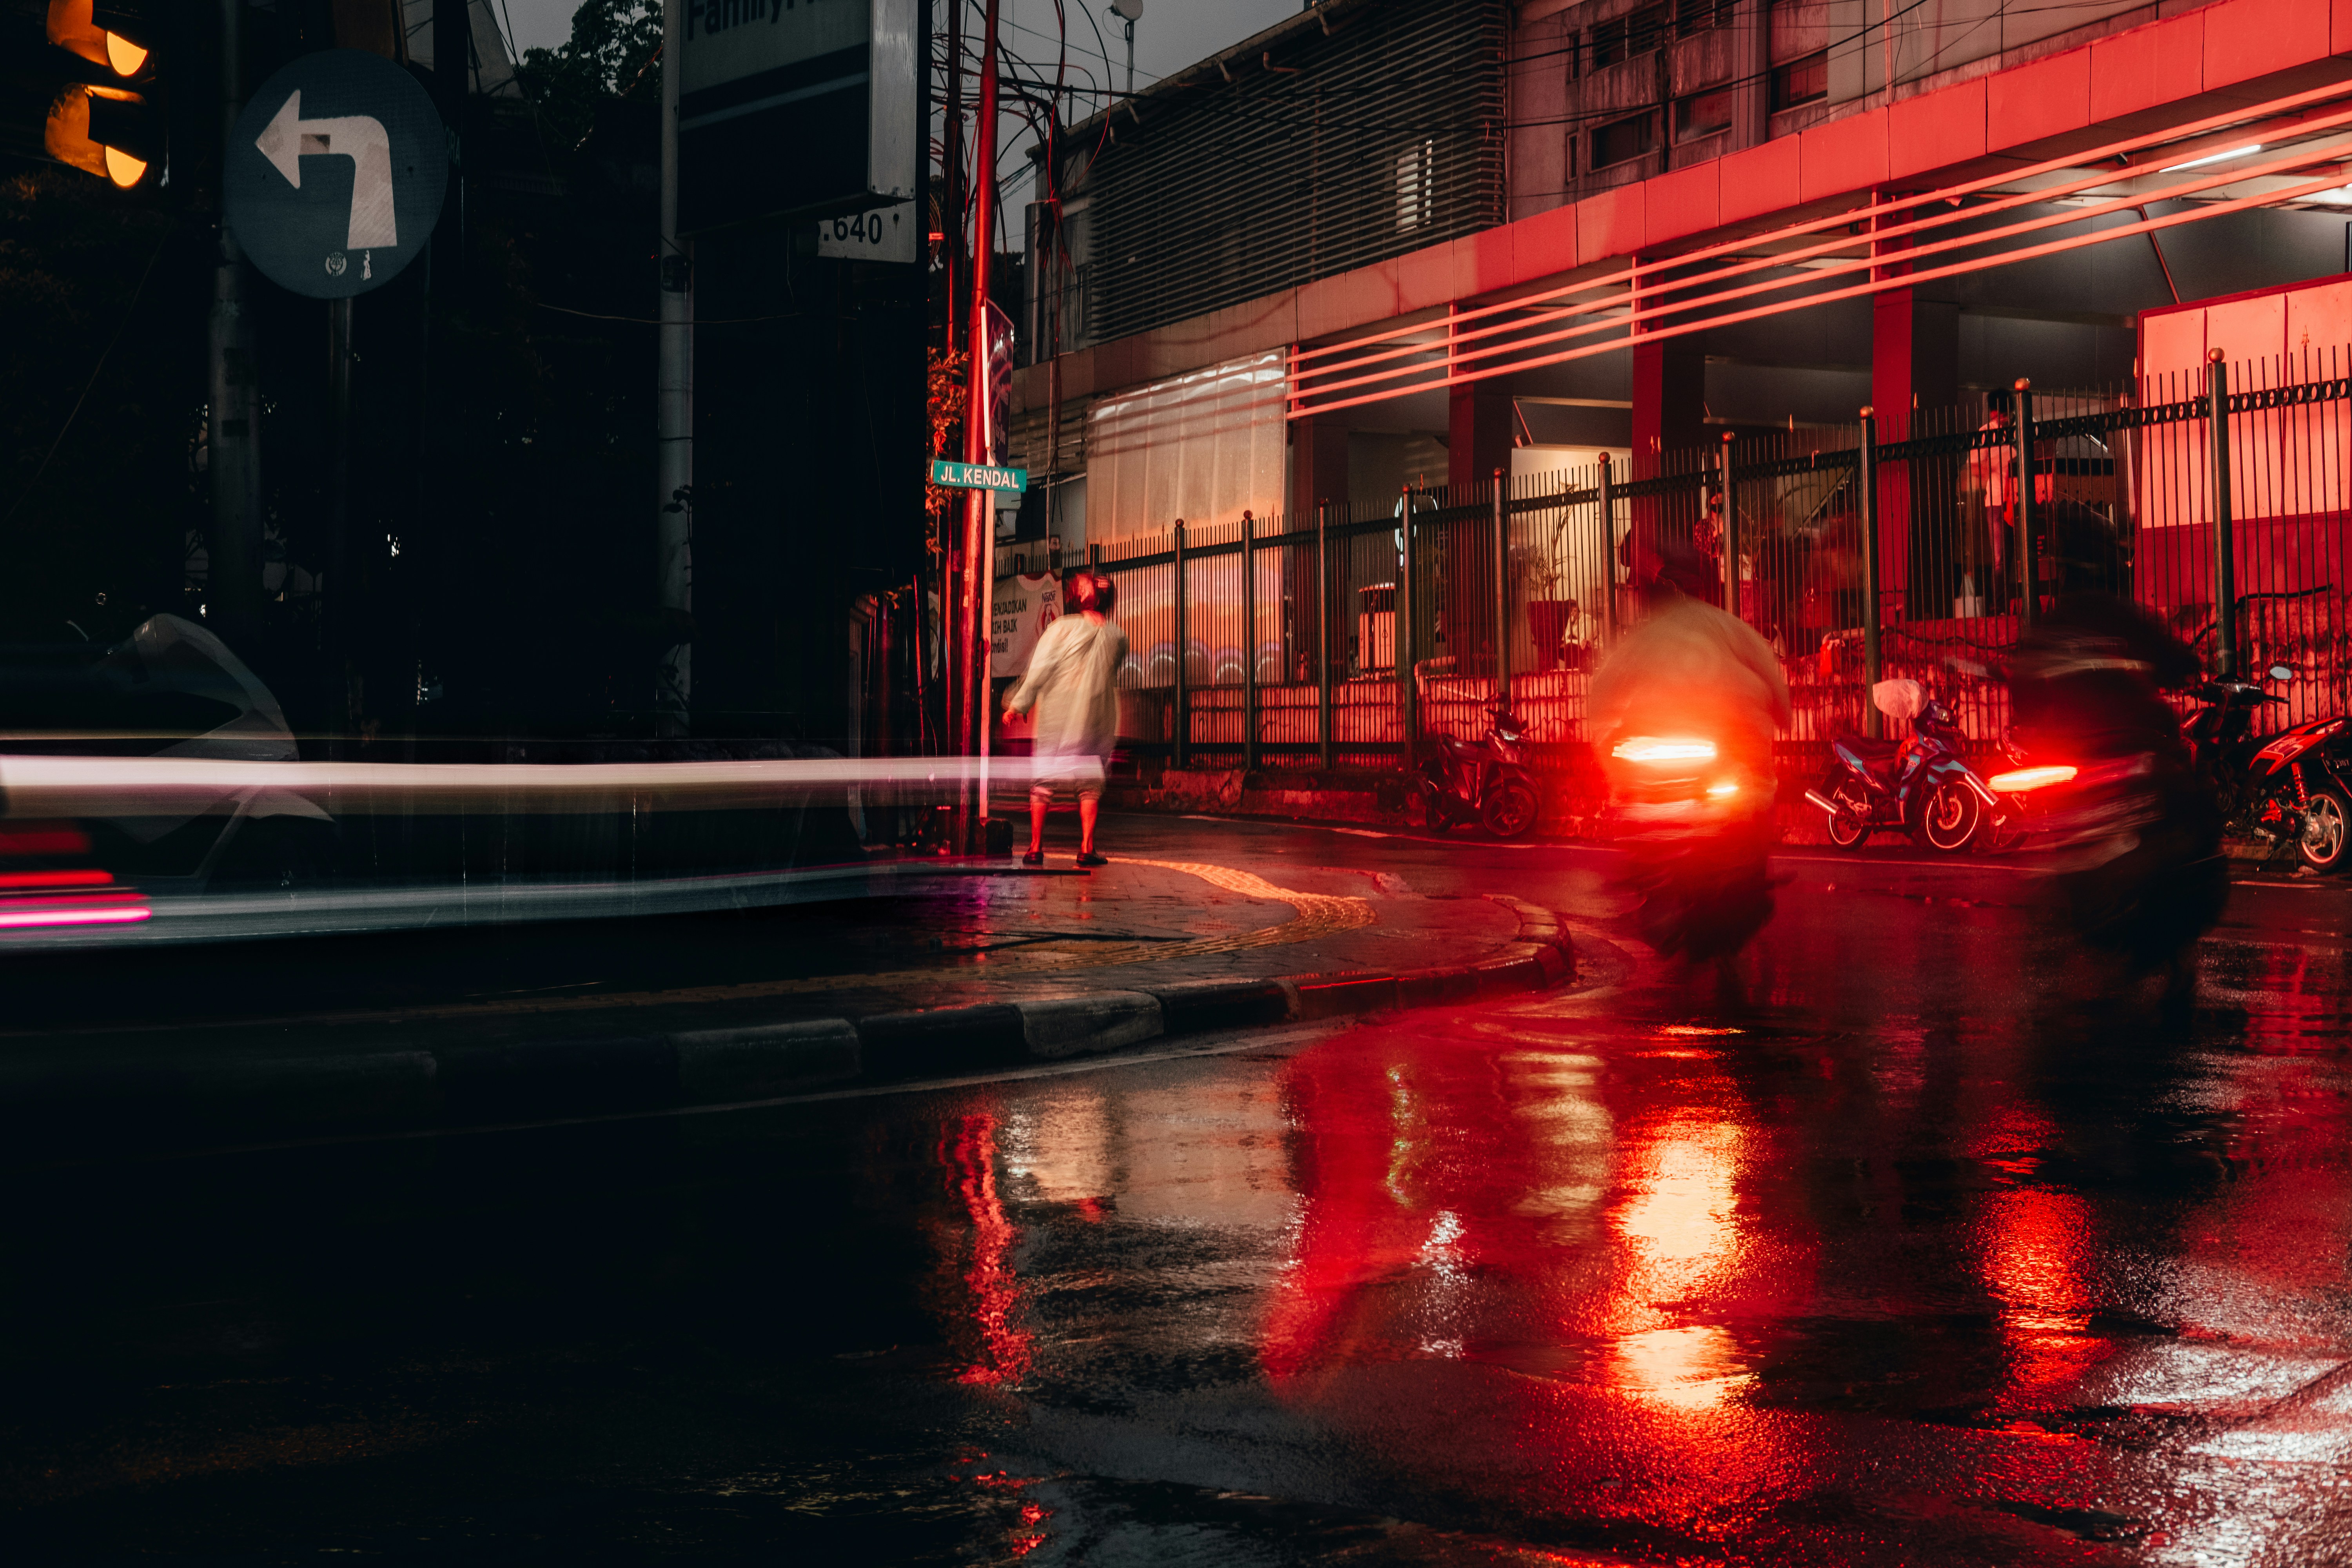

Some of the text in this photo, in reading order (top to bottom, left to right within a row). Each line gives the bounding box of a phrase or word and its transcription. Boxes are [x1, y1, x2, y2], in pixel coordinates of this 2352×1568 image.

[817, 213, 882, 244] .640
[941, 465, 1019, 488] JL. KENDAL
[992, 599, 1027, 617] ENJADIKAN
[1003, 618, 1017, 633] BAIK
